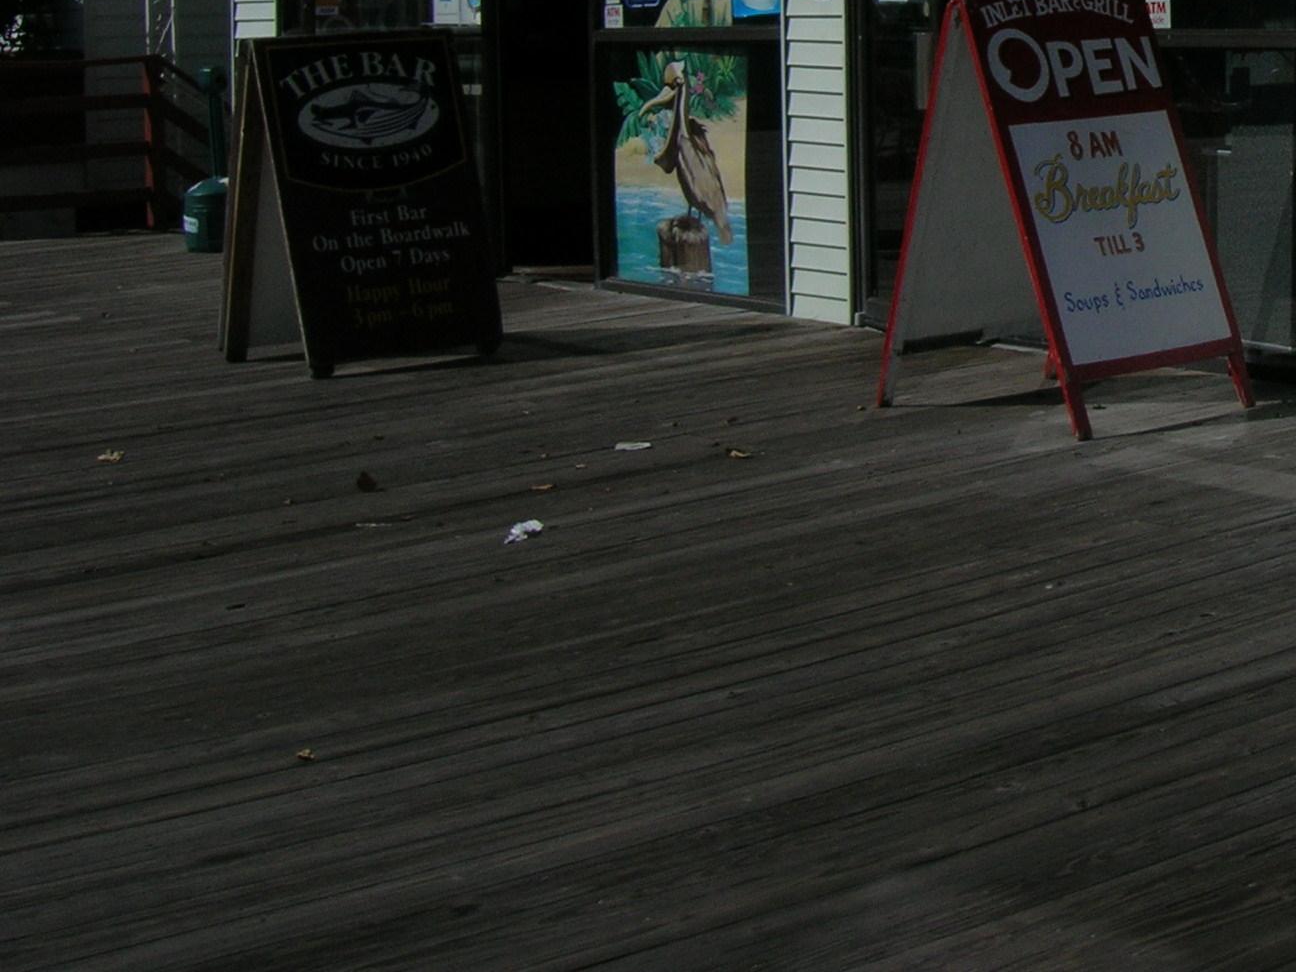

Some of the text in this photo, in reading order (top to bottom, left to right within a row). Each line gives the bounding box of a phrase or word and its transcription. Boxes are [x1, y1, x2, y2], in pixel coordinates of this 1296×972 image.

[279, 51, 438, 100] THE BAR
[987, 28, 1164, 103] OPEN
[319, 151, 385, 171] SINCE
[1066, 130, 1124, 161] 8 AM
[1034, 153, 1181, 229] Breakfast
[351, 203, 428, 227] First Bar
[312, 220, 472, 253] On the Boardwalk
[1093, 232, 1146, 257] TILL 3
[340, 254, 388, 276] Open
[408, 246, 451, 268] Days
[346, 277, 451, 306] Happy Hour
[1063, 291, 1110, 314] Soups
[1125, 275, 1205, 301] Sandwiches
